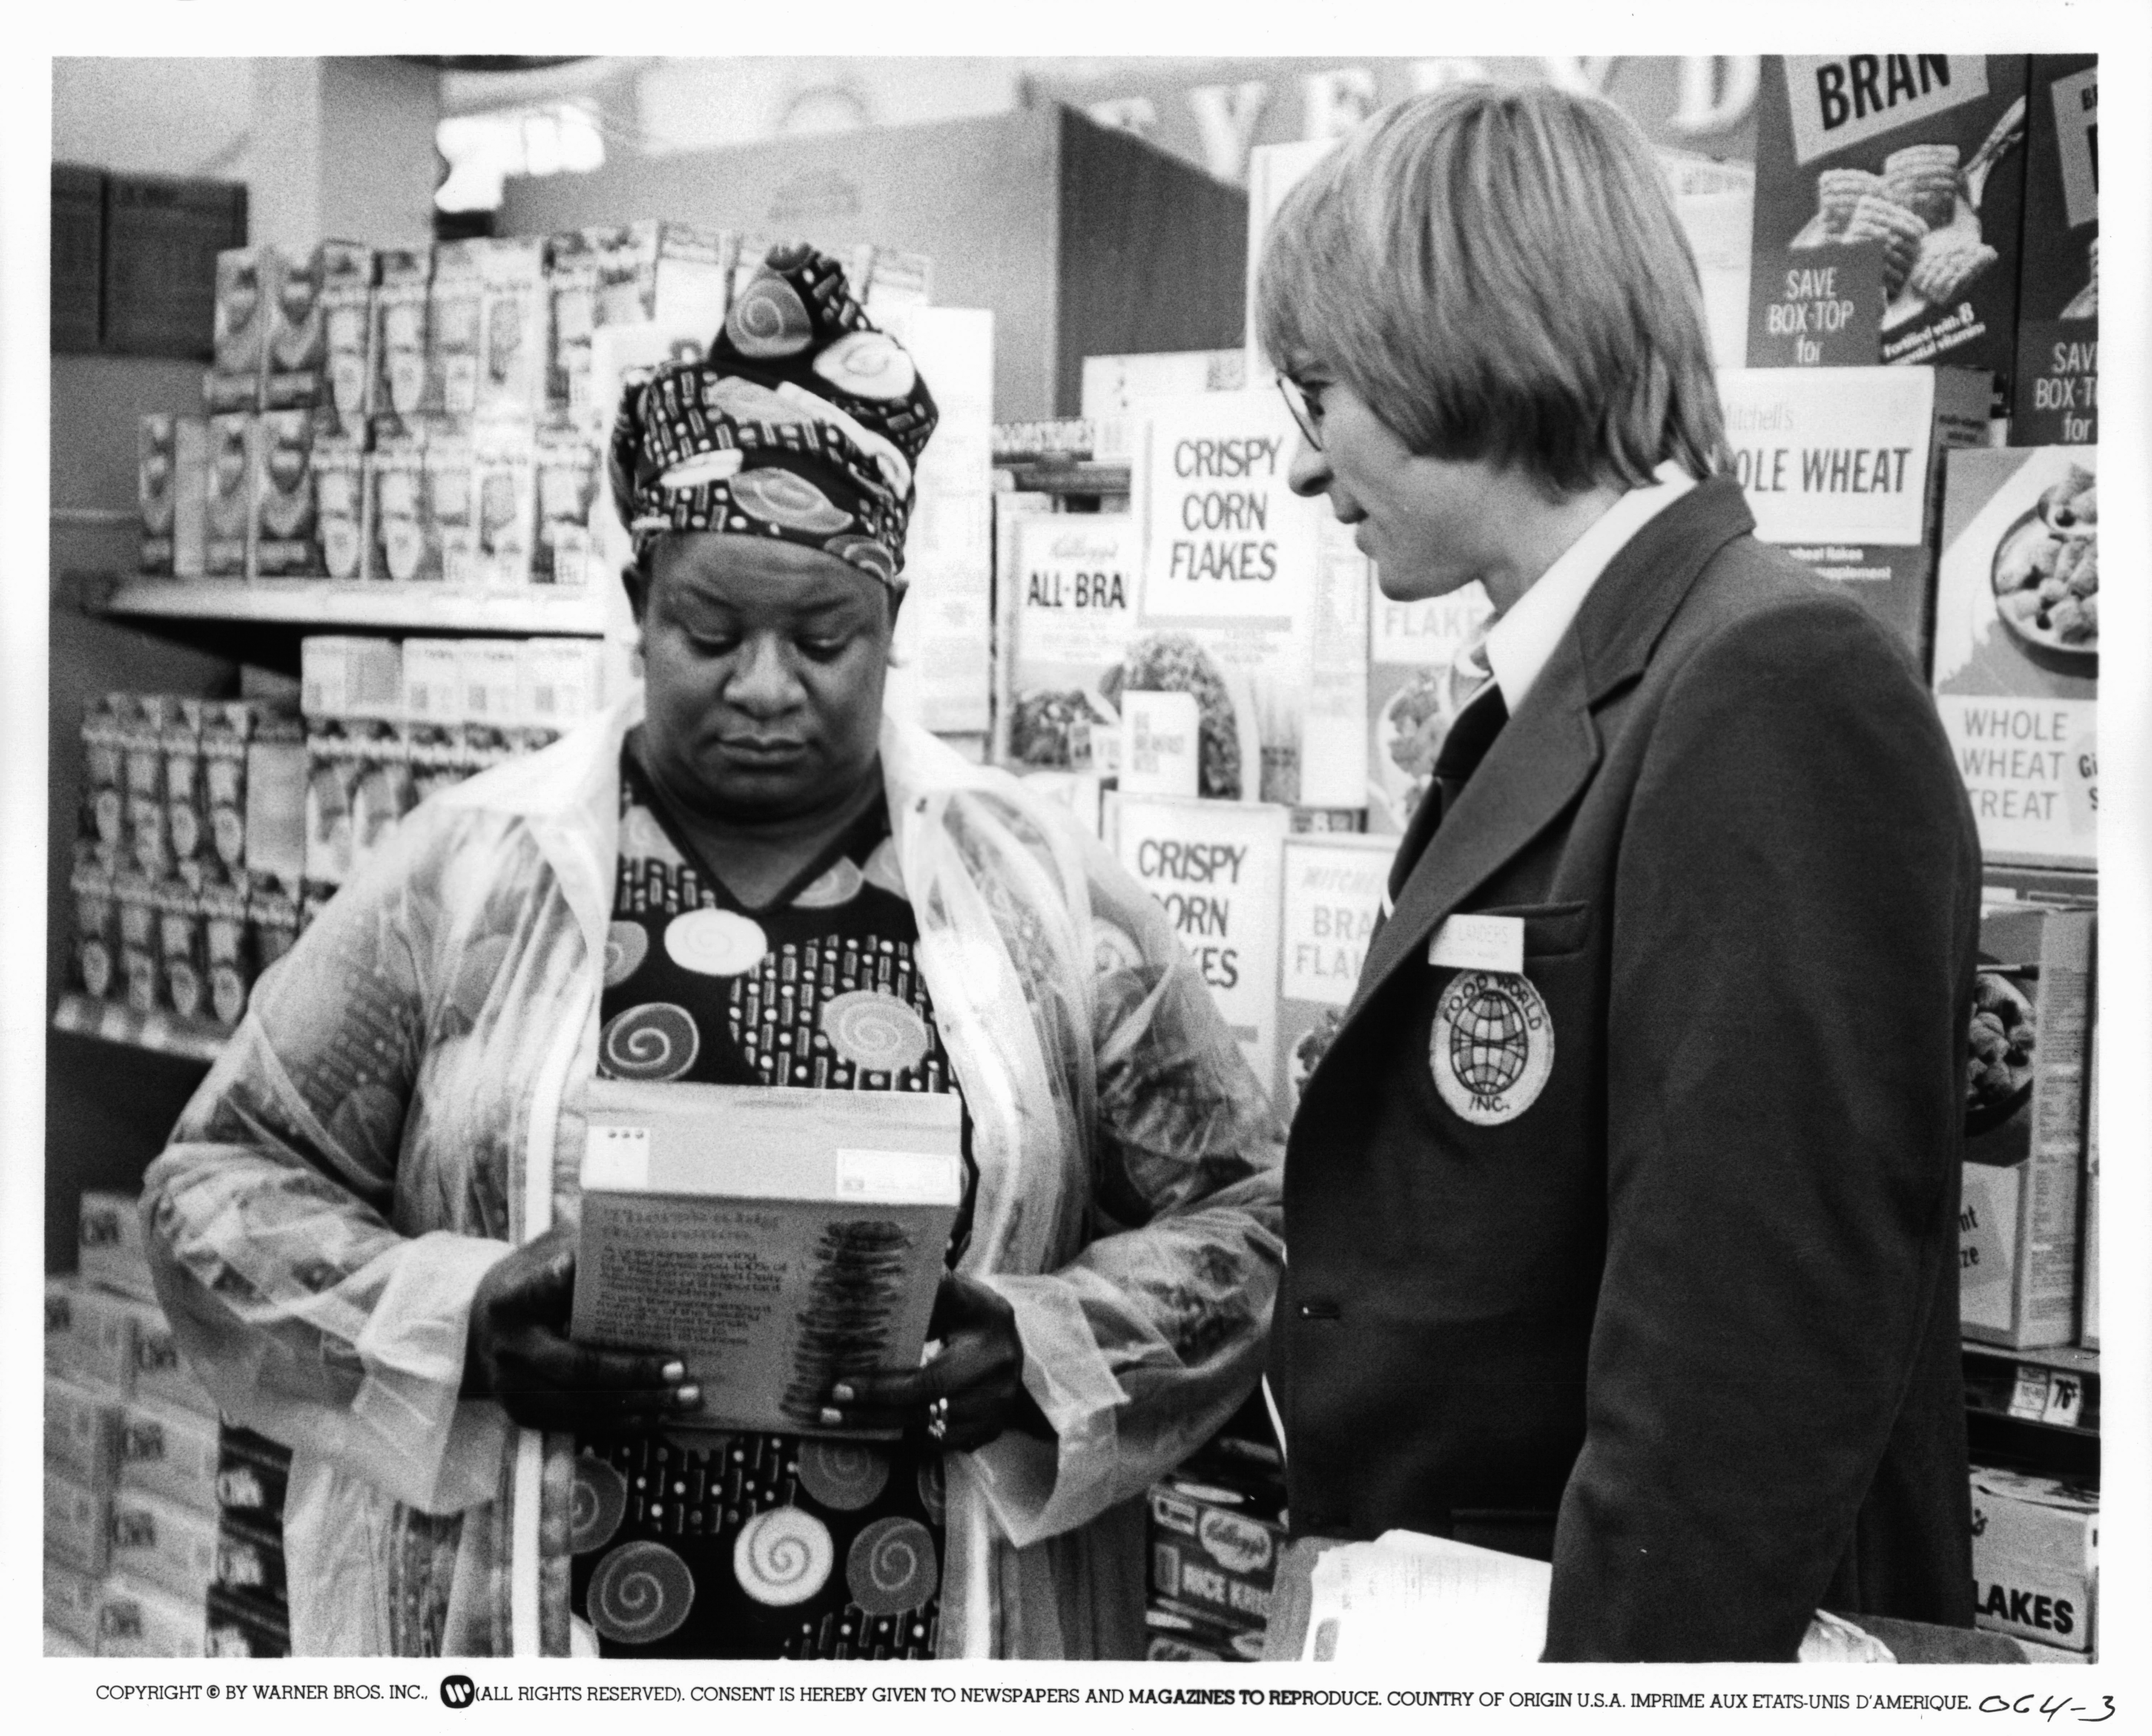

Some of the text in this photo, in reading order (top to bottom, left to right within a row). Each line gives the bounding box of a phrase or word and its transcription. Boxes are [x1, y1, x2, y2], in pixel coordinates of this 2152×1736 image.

[1816, 55, 1951, 131] BRAN
[1785, 267, 1837, 300] SAVE
[1768, 302, 1854, 334] BOX-TOP
[1797, 334, 1823, 363] for
[2053, 342, 2097, 375] SAV
[2035, 377, 2097, 409] BOX-T
[2064, 411, 2093, 441] for
[1174, 436, 1284, 479] CRISPY
[1737, 447, 1913, 493] OLE WHEAT
[1183, 490, 1267, 532] CORN
[1169, 540, 1278, 583] FLAKES
[1026, 570, 1127, 610] ALL-BRA
[1964, 707, 2069, 741] WHOLE
[1963, 748, 2067, 780] WHEAT
[1138, 838, 1248, 885] CRISPY
[1152, 892, 1230, 938] ORN
[1443, 972, 1543, 1030] FOOD WORLD
[1469, 1095, 1510, 1112] INC.
[1973, 1579, 2075, 1634] LAKES
